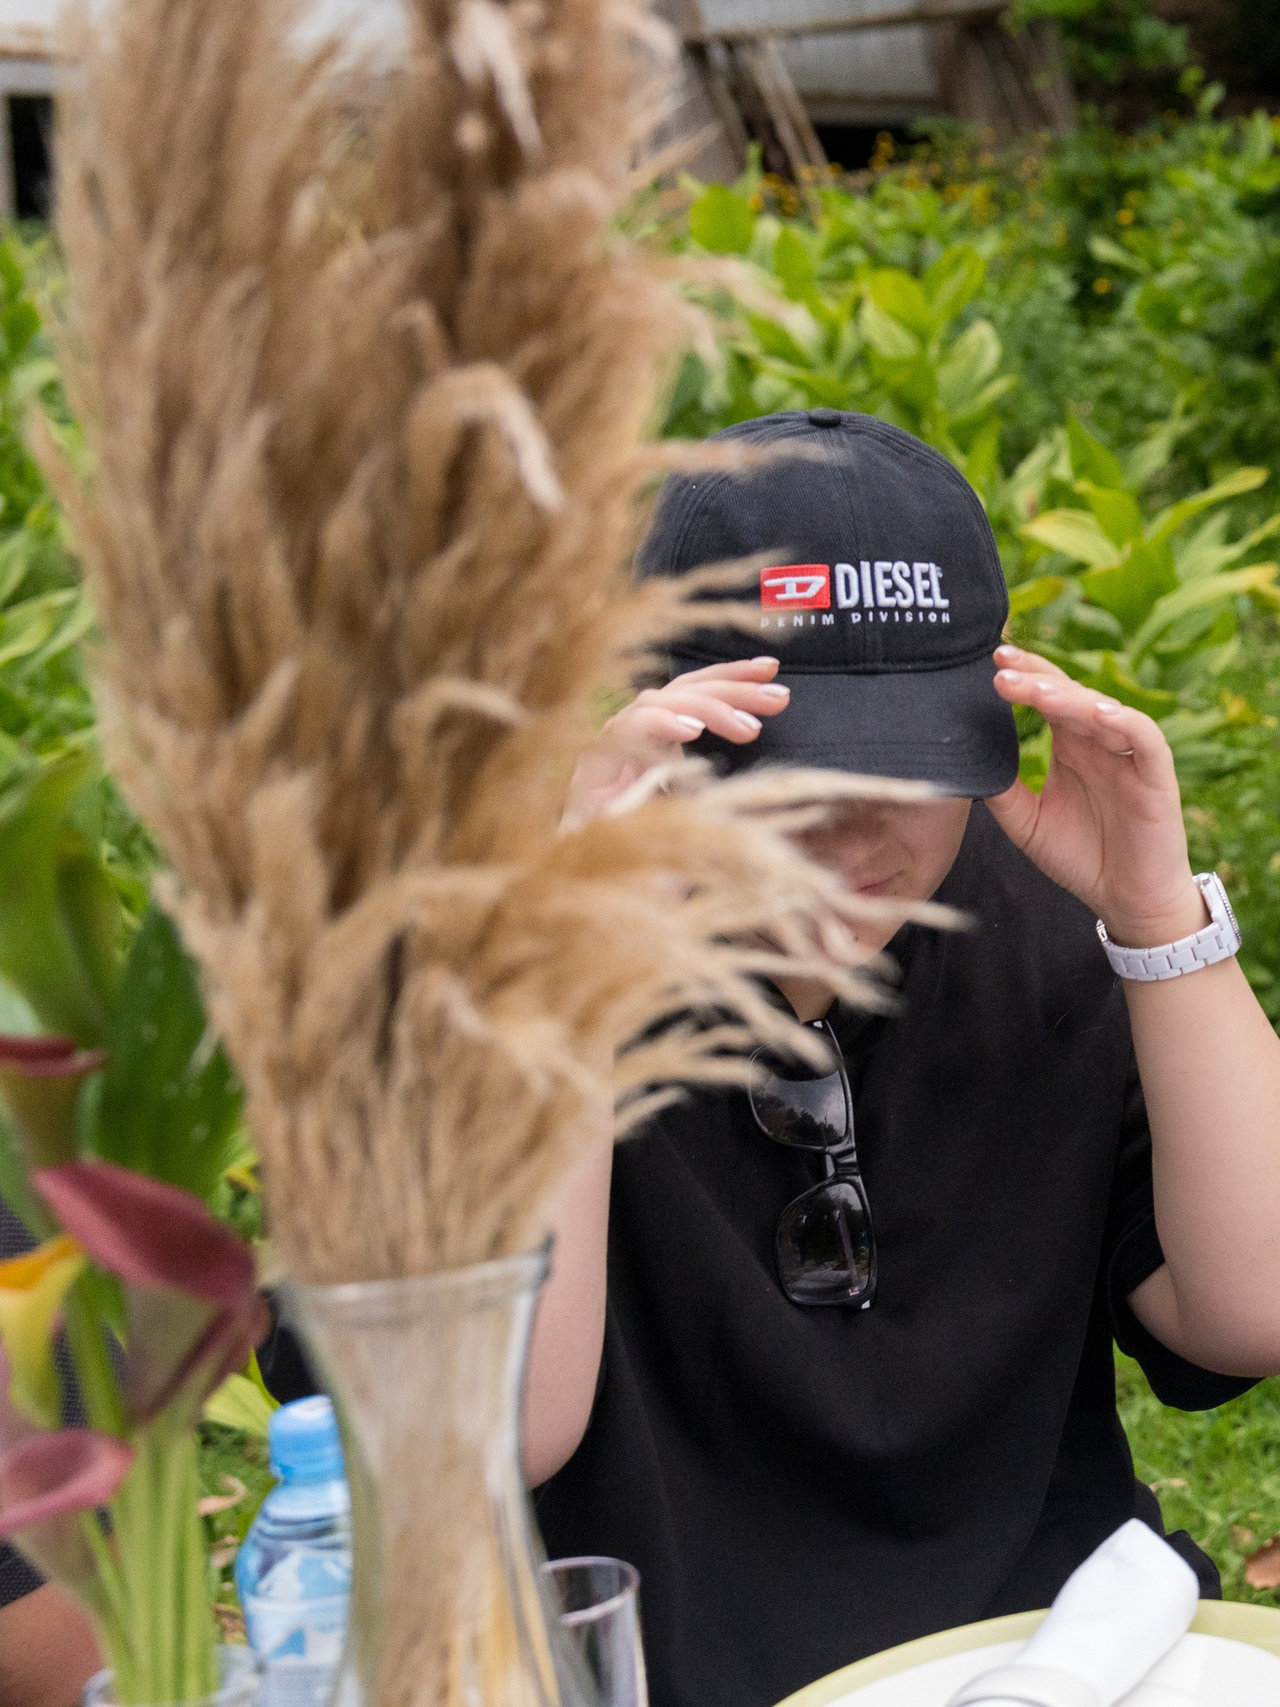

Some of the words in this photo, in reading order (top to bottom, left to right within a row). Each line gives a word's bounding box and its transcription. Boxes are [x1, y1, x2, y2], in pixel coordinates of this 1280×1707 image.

[834, 560, 950, 610] DIESEL
[760, 613, 835, 628] DENIM
[851, 611, 951, 624] DIVISION
